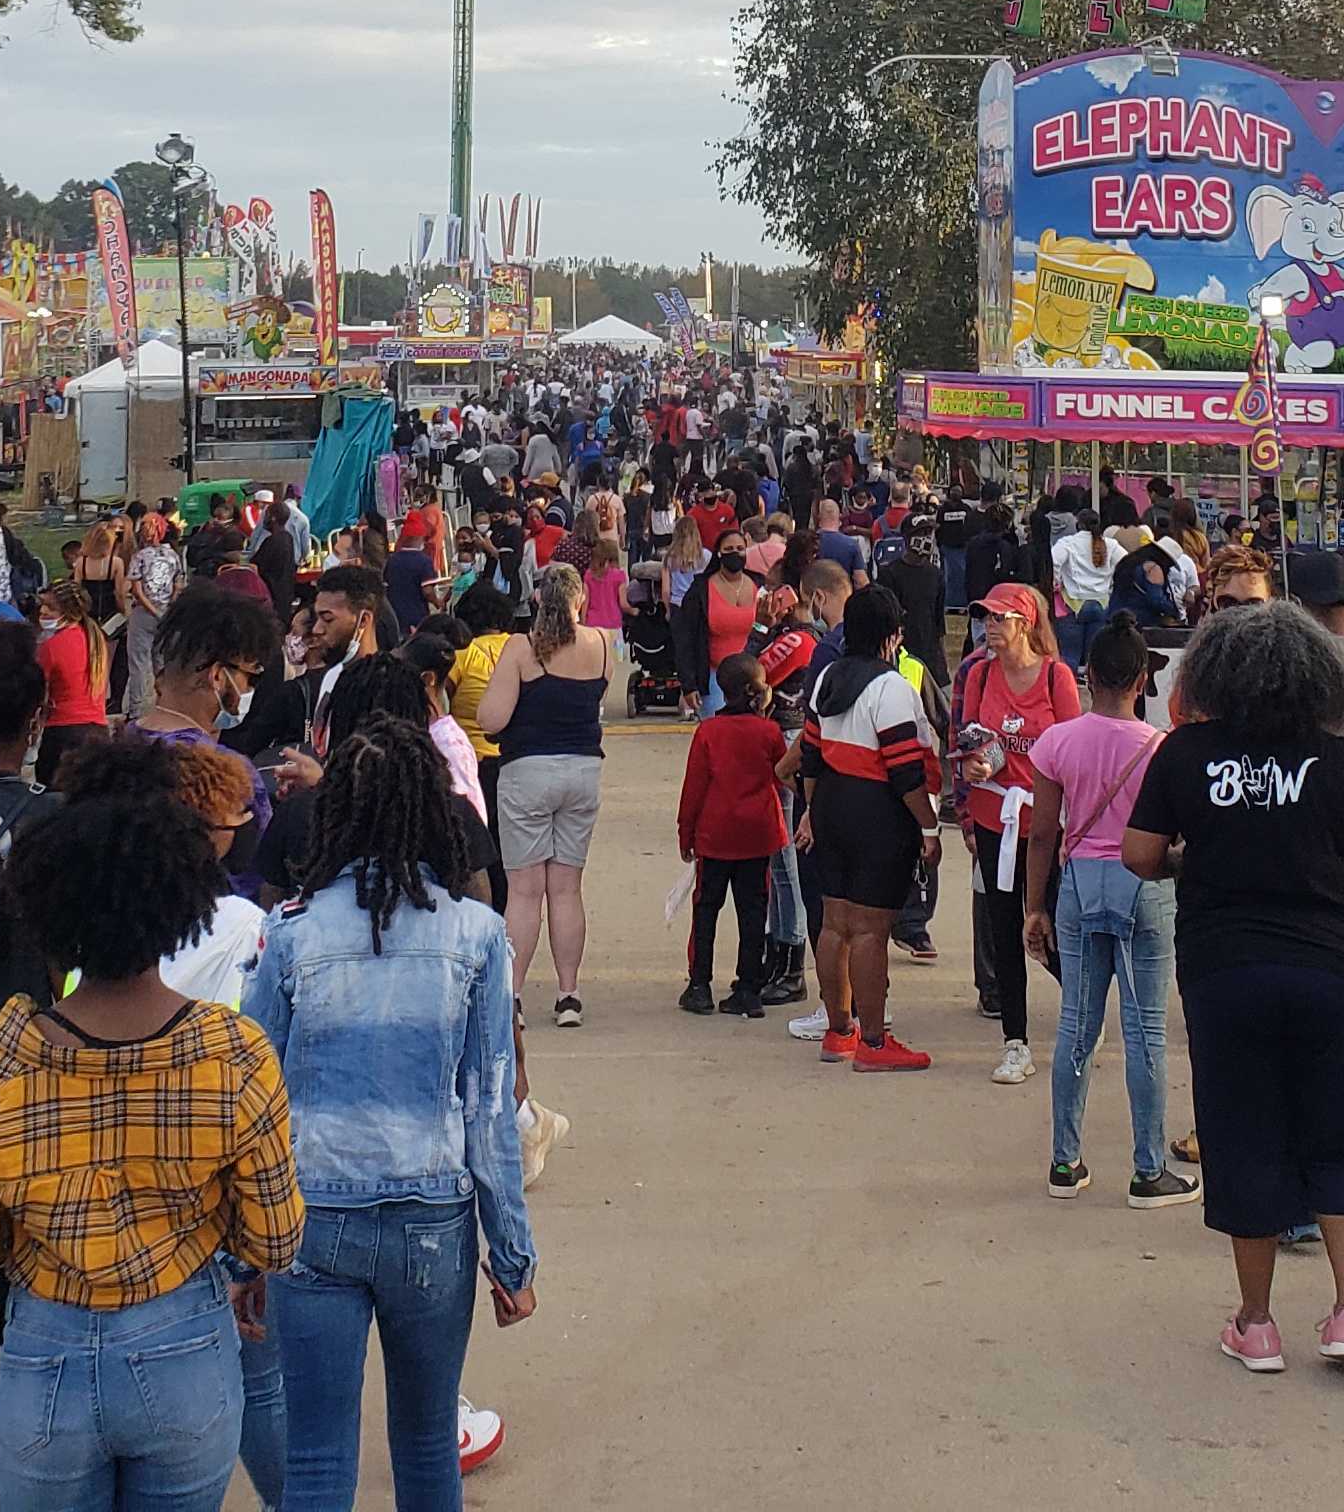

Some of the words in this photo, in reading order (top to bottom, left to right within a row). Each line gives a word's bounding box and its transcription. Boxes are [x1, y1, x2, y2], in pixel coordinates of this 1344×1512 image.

[1031, 97, 1291, 174] ELEPHANT
[1093, 174, 1234, 236] EARS
[1128, 295, 1174, 315] FRESH
[1175, 300, 1250, 322] SQUEEZED
[1056, 393, 1195, 420] FUNNEL
[1202, 396, 1329, 424] CKES
